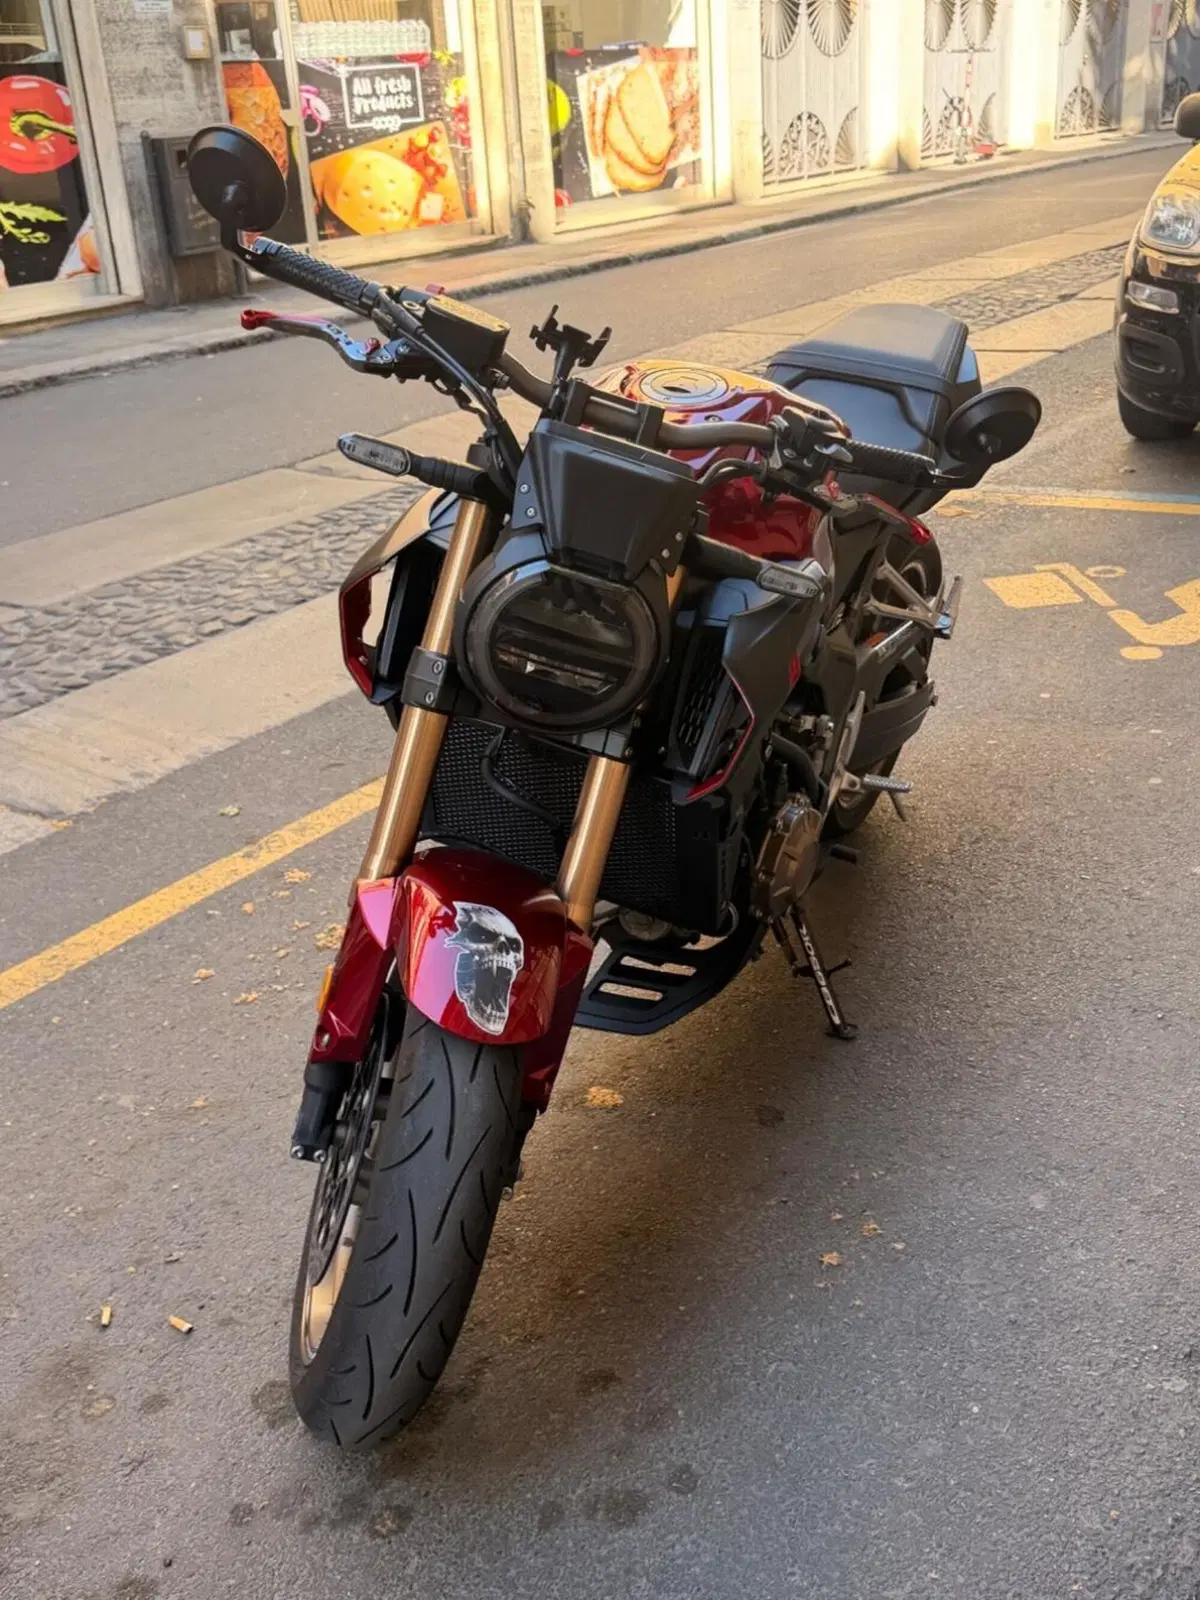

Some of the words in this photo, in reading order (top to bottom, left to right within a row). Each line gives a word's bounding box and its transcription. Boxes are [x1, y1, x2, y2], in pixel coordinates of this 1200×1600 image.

[353, 77, 373, 95] All
[374, 75, 412, 95] fresh
[353, 93, 414, 114] Products
